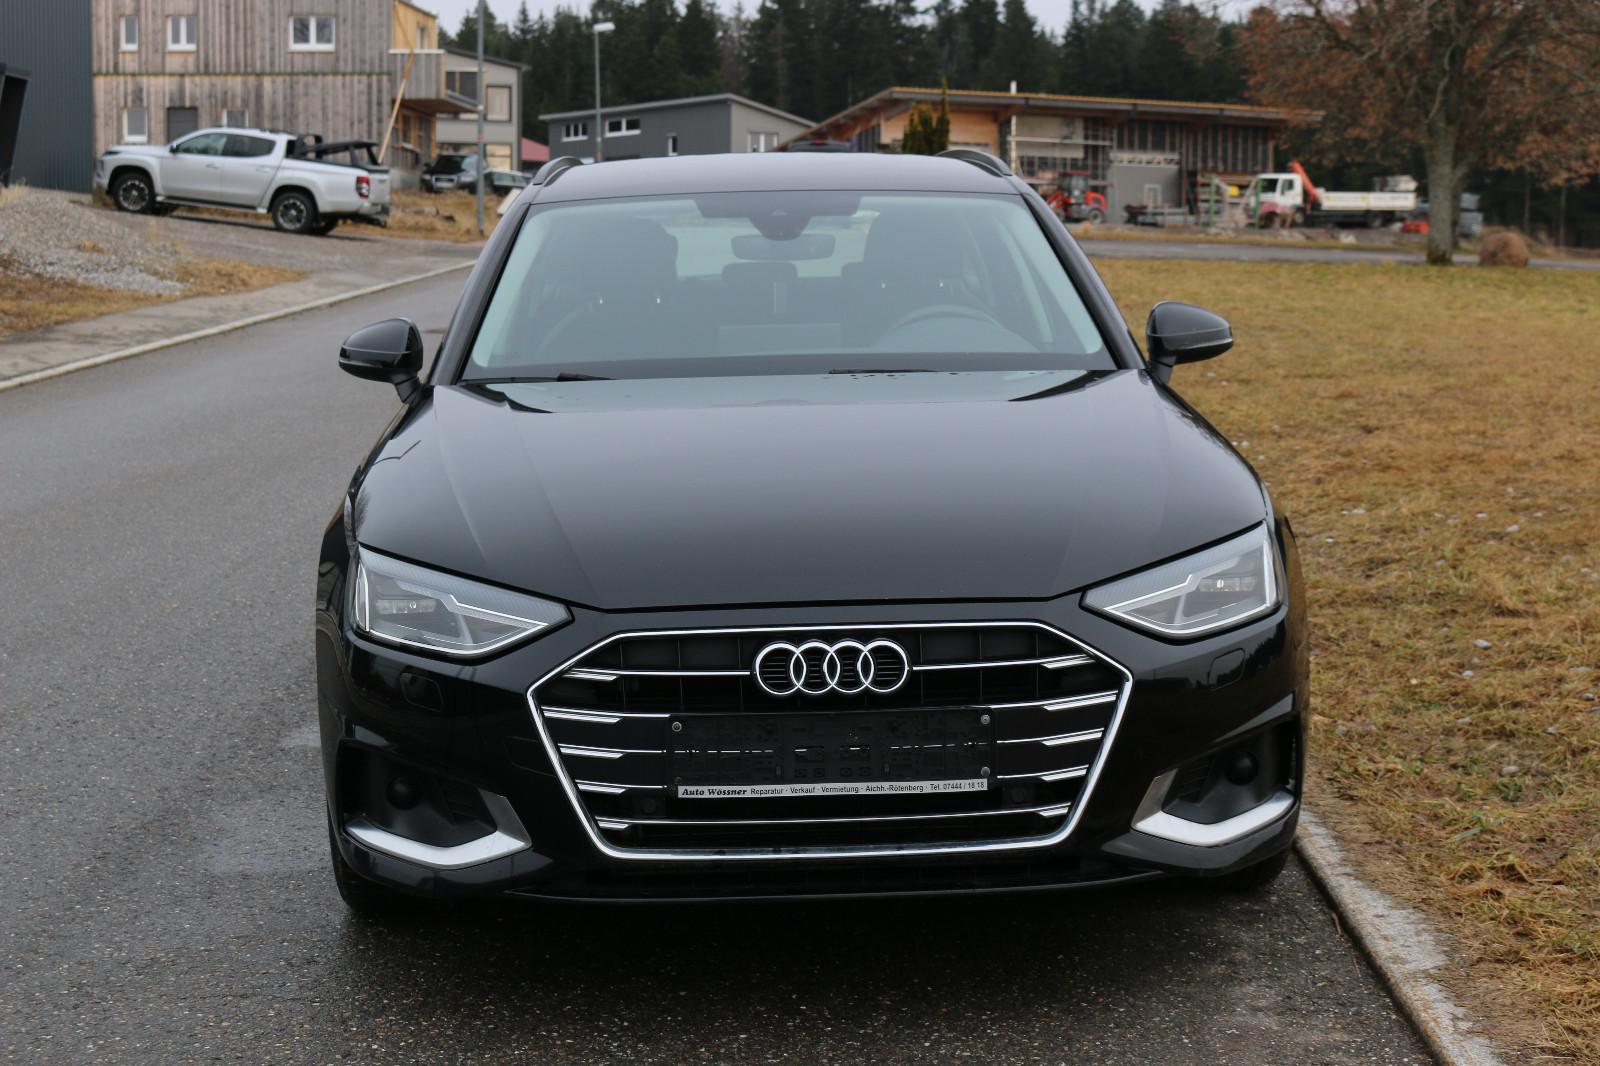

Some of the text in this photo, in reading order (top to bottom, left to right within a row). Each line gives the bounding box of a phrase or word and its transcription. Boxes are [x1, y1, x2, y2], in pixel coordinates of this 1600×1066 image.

[682, 788, 705, 796] Auto
[707, 787, 748, 796] Wössner
[750, 787, 784, 796] Reparatur
[790, 786, 816, 794] Verkauf
[821, 784, 859, 794] Vermietung
[929, 782, 943, 791] Tel.
[943, 782, 962, 790] 07444
